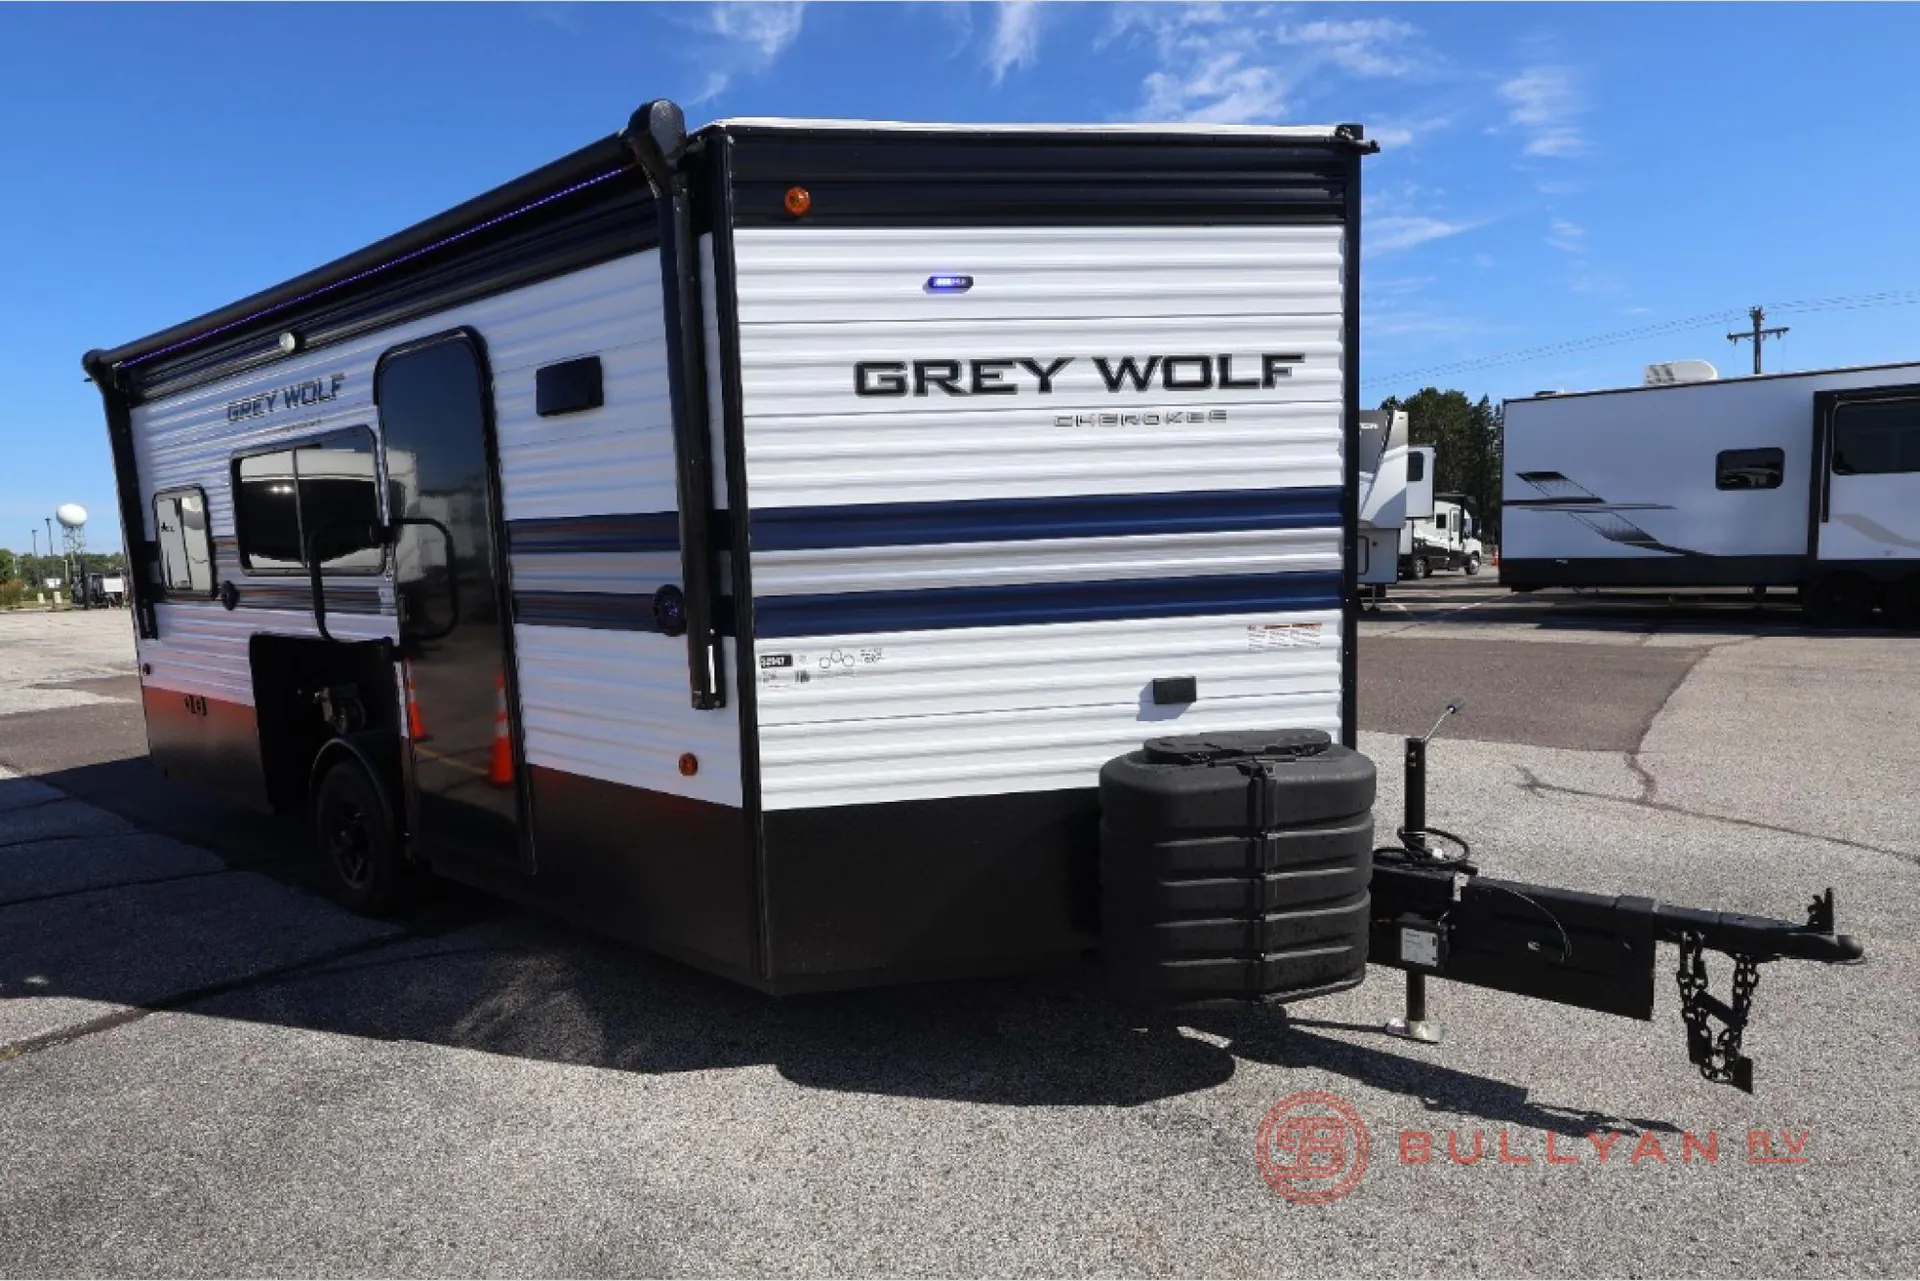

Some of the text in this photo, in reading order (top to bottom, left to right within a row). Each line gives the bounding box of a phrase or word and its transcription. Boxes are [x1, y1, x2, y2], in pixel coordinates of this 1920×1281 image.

[228, 373, 346, 421] GREY WOLF
[854, 353, 1307, 398] GREY WOLF
[1053, 410, 1229, 429] CHEROKEE
